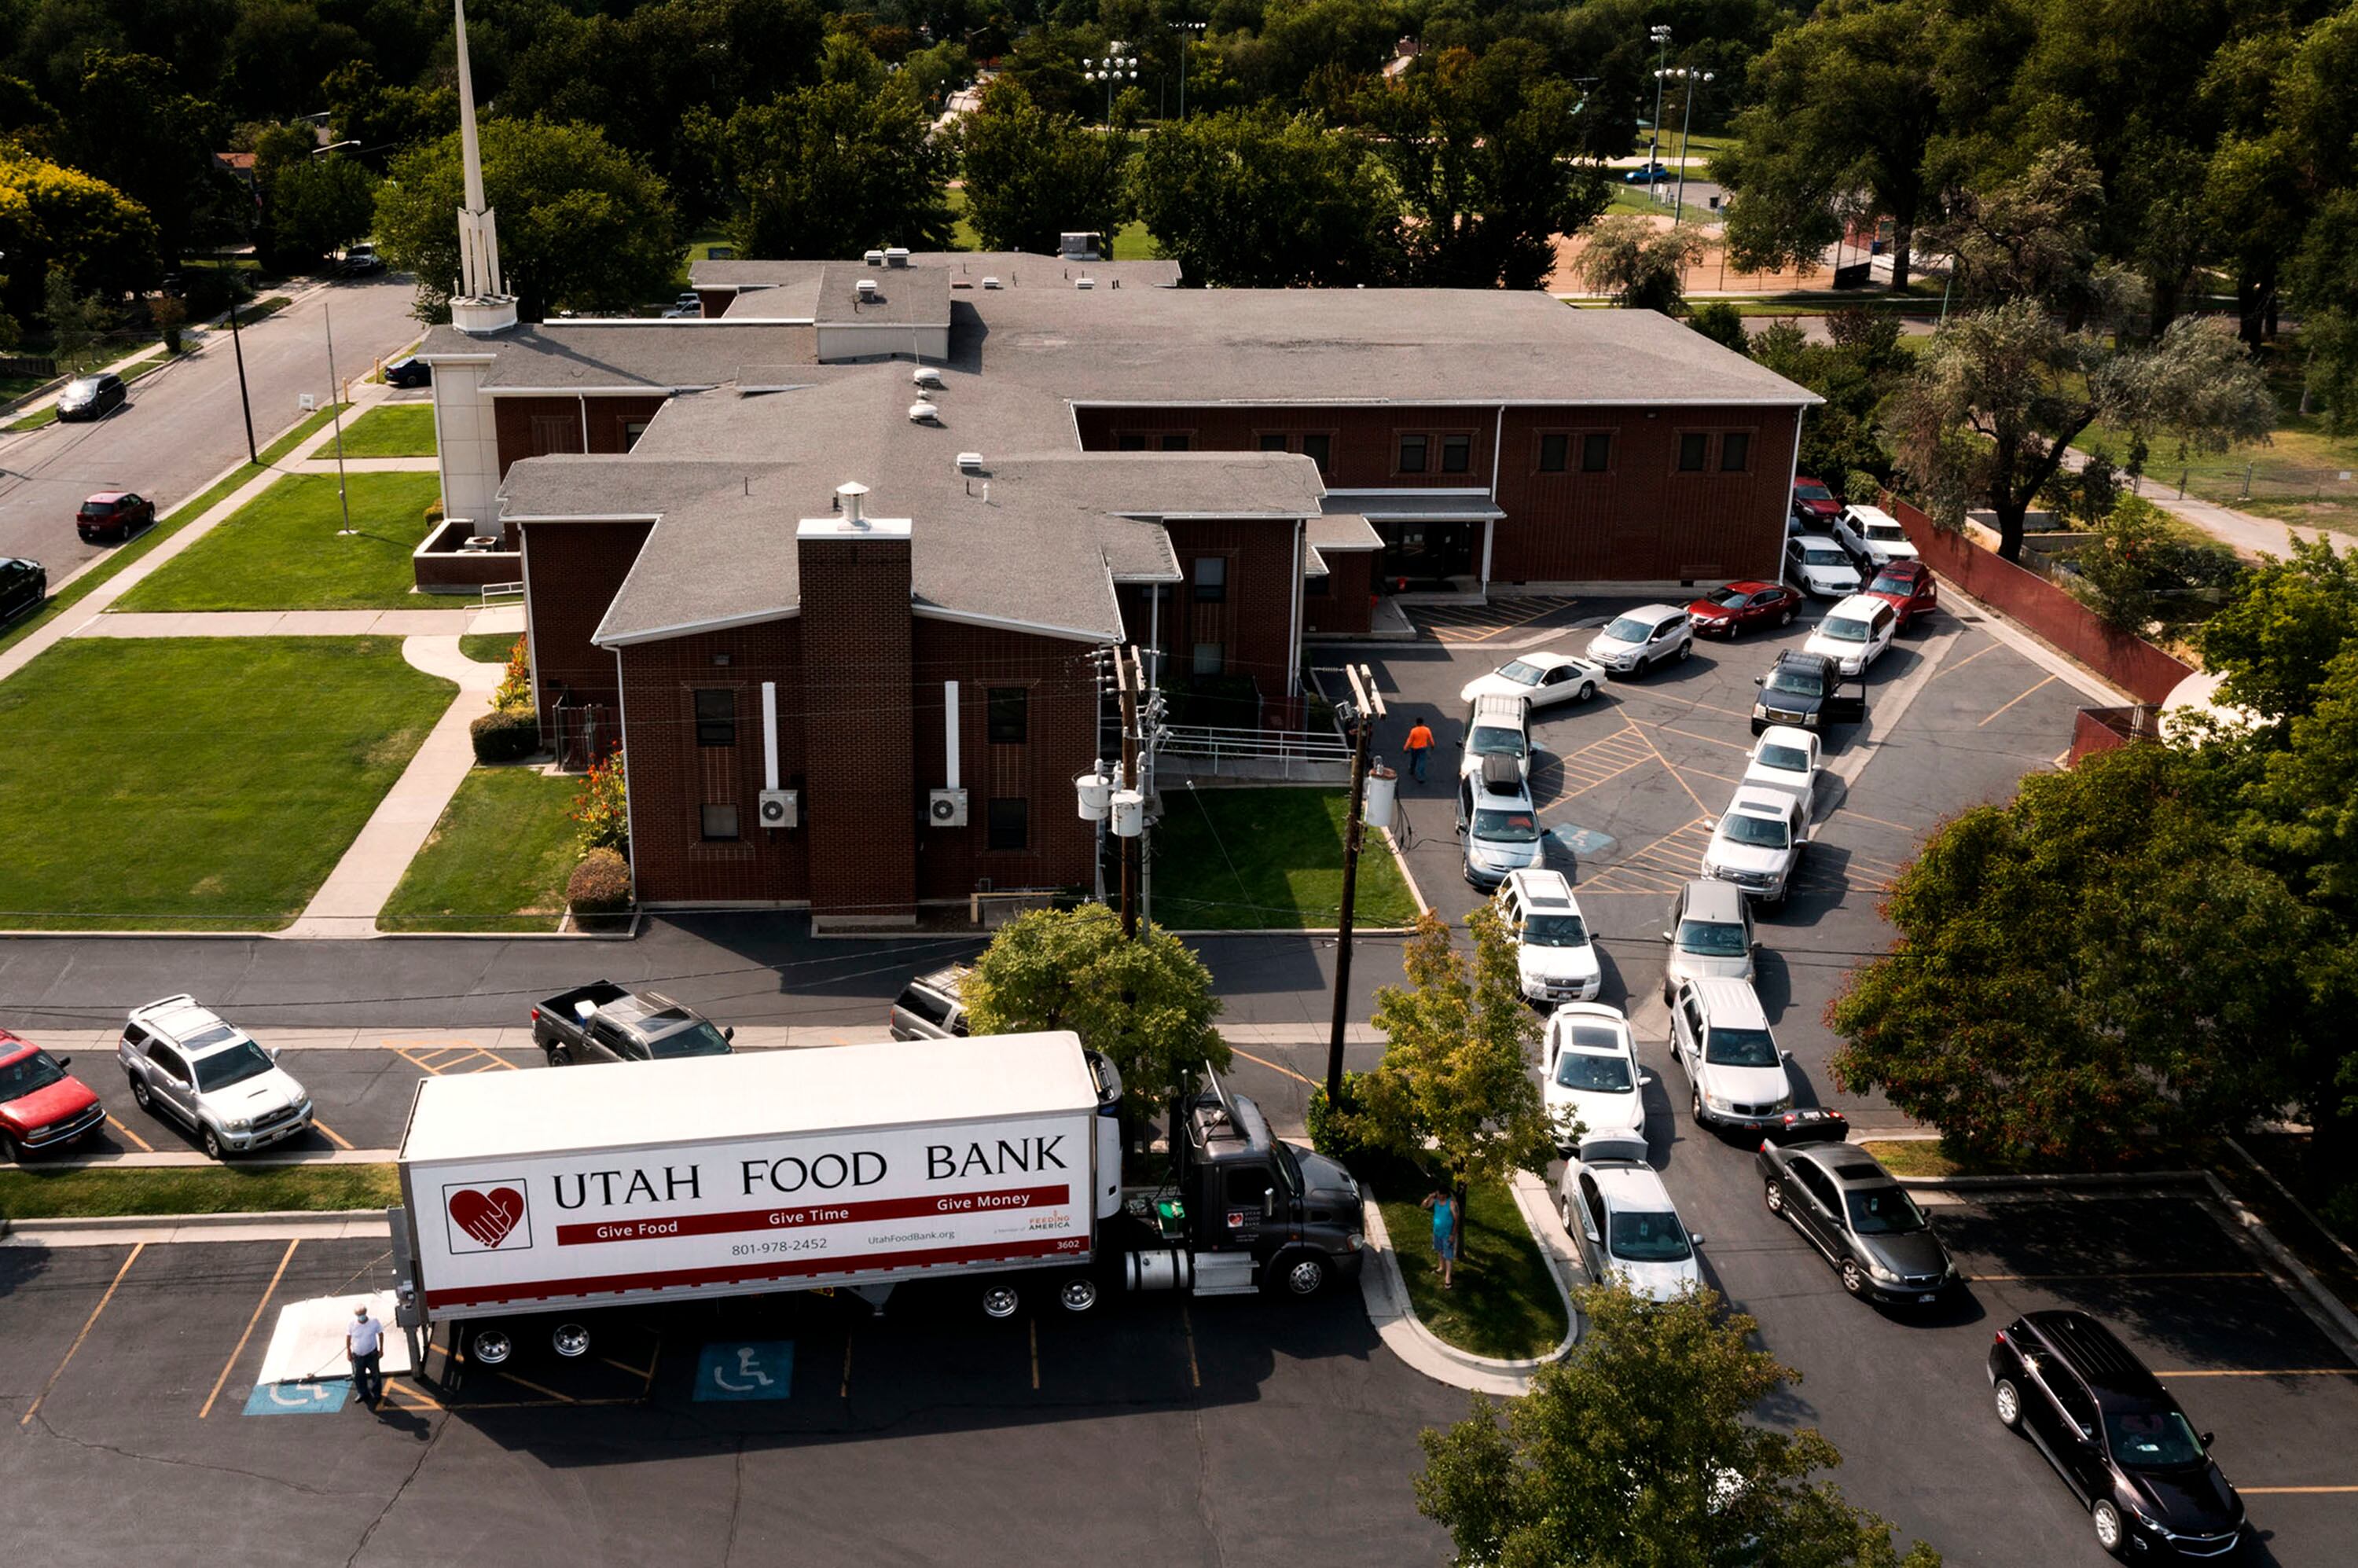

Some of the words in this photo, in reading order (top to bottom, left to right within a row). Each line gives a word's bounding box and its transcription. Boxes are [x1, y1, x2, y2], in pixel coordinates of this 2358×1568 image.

[553, 1164, 702, 1209] UTAH
[740, 1151, 887, 1195] FOOD
[925, 1135, 1068, 1180] BANK
[937, 1198, 972, 1211] Give
[977, 1193, 1030, 1207] Money
[769, 1211, 805, 1225] Give
[809, 1208, 850, 1221] Time
[1029, 1214, 1070, 1224] FEEDING
[597, 1225, 633, 1239] Give
[638, 1221, 678, 1236] Food
[1029, 1221, 1070, 1231] AMERICA
[868, 1230, 956, 1245] UtahFoodBank.org
[1056, 1239, 1080, 1250] 3602
[732, 1238, 828, 1256] 801-978-2452
